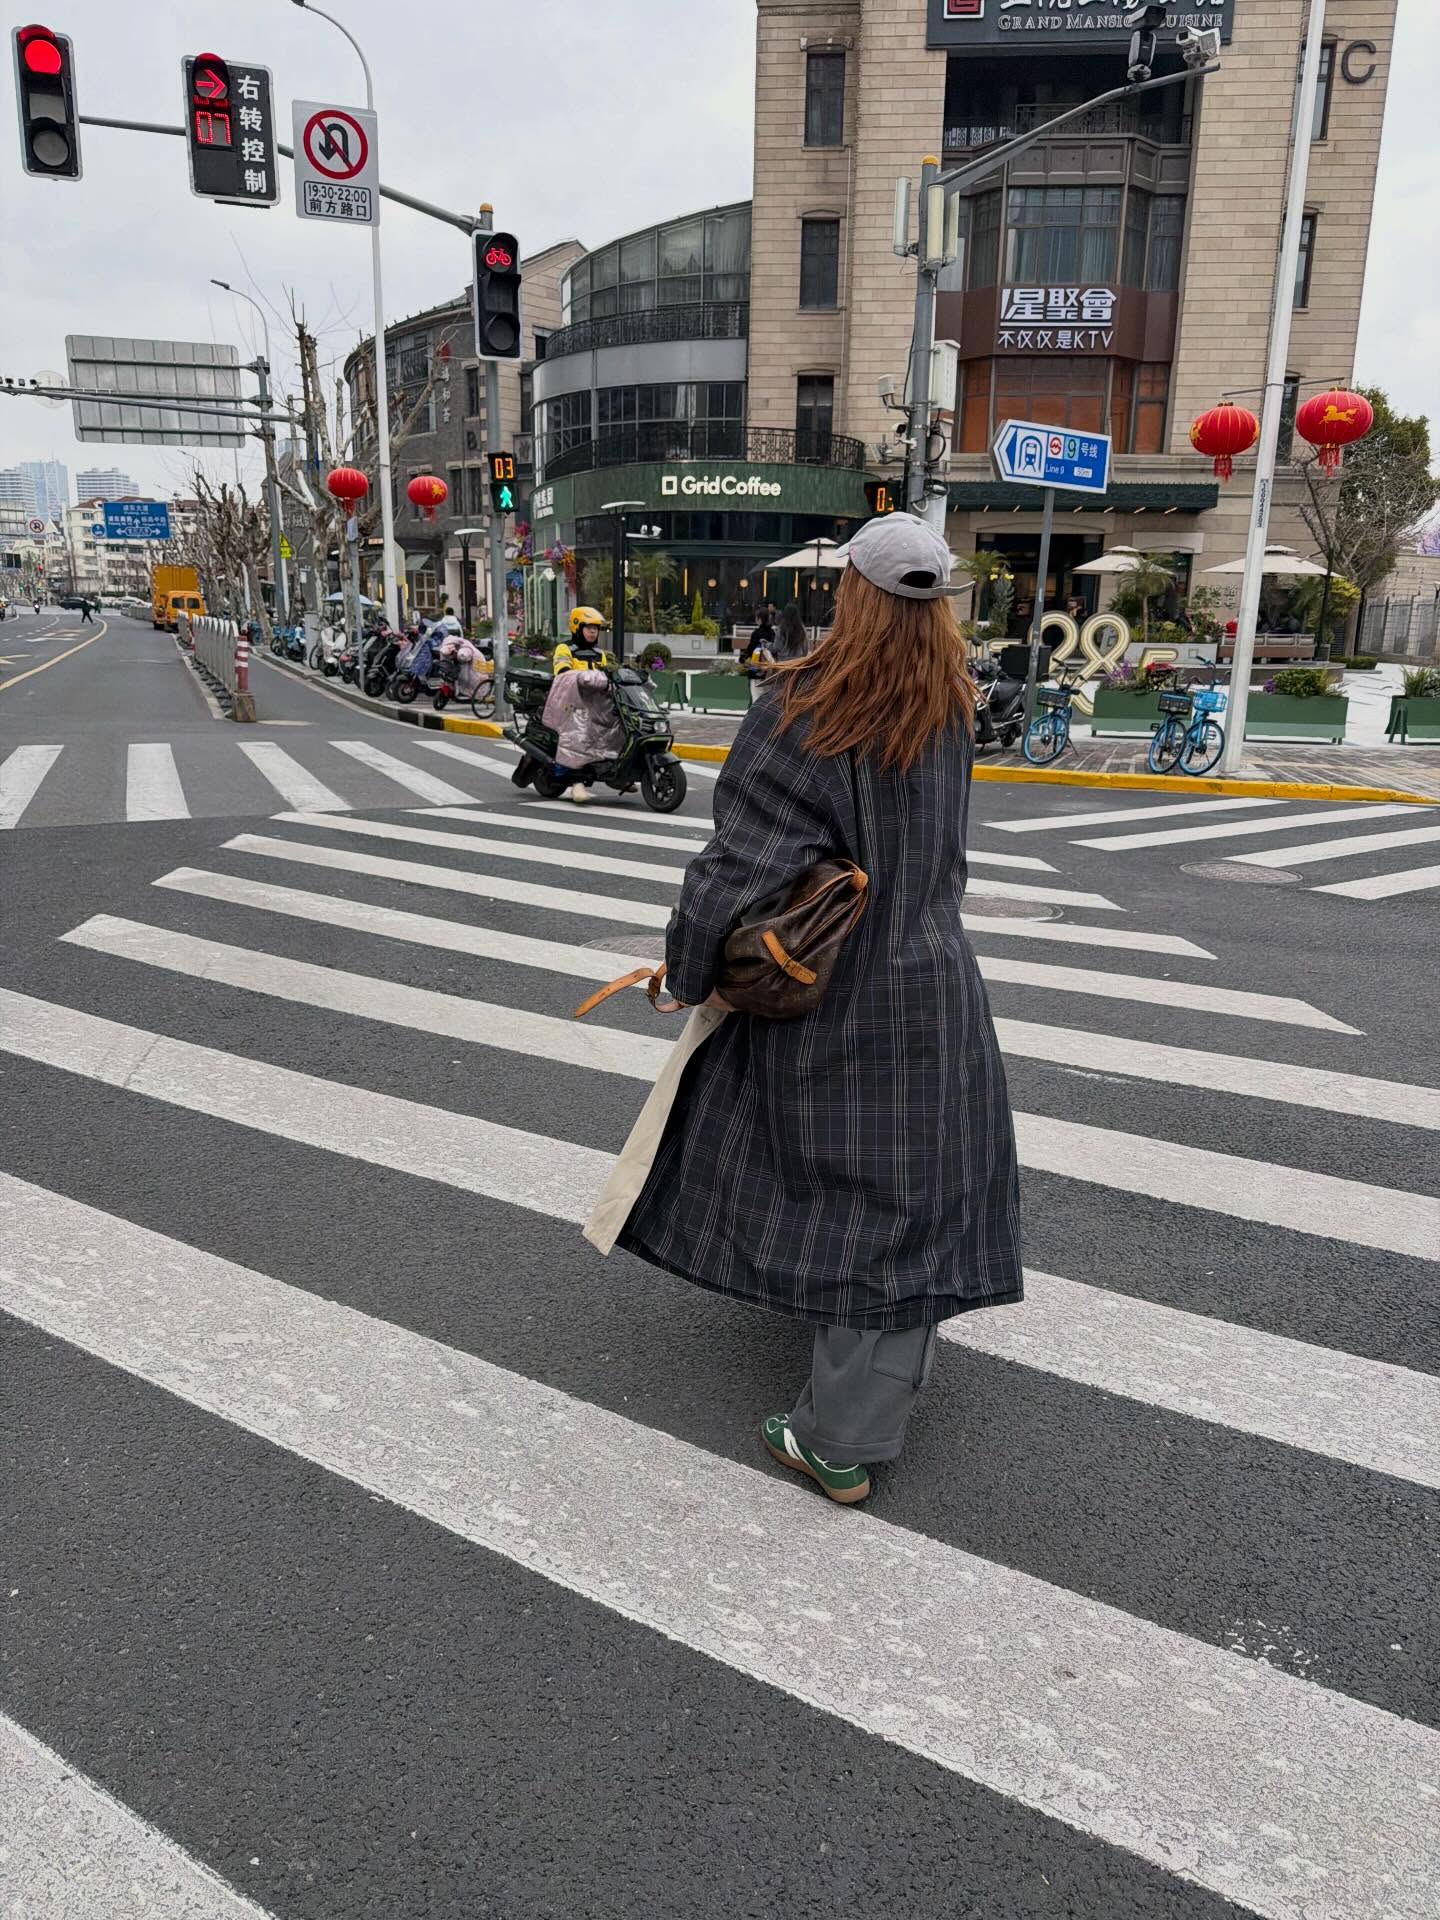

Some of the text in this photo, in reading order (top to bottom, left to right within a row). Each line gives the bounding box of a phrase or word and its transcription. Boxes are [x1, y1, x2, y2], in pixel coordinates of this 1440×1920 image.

[998, 14, 1062, 30] GRAND
[1341, 40, 1377, 84] C
[237, 74, 268, 194] 右转控制
[309, 198, 367, 217] 前方路口
[998, 330, 1114, 349] 不仅仅是KTV
[1067, 439, 1098, 459] 9 号线
[495, 458, 514, 479] 03
[1045, 463, 1065, 475] Line 9
